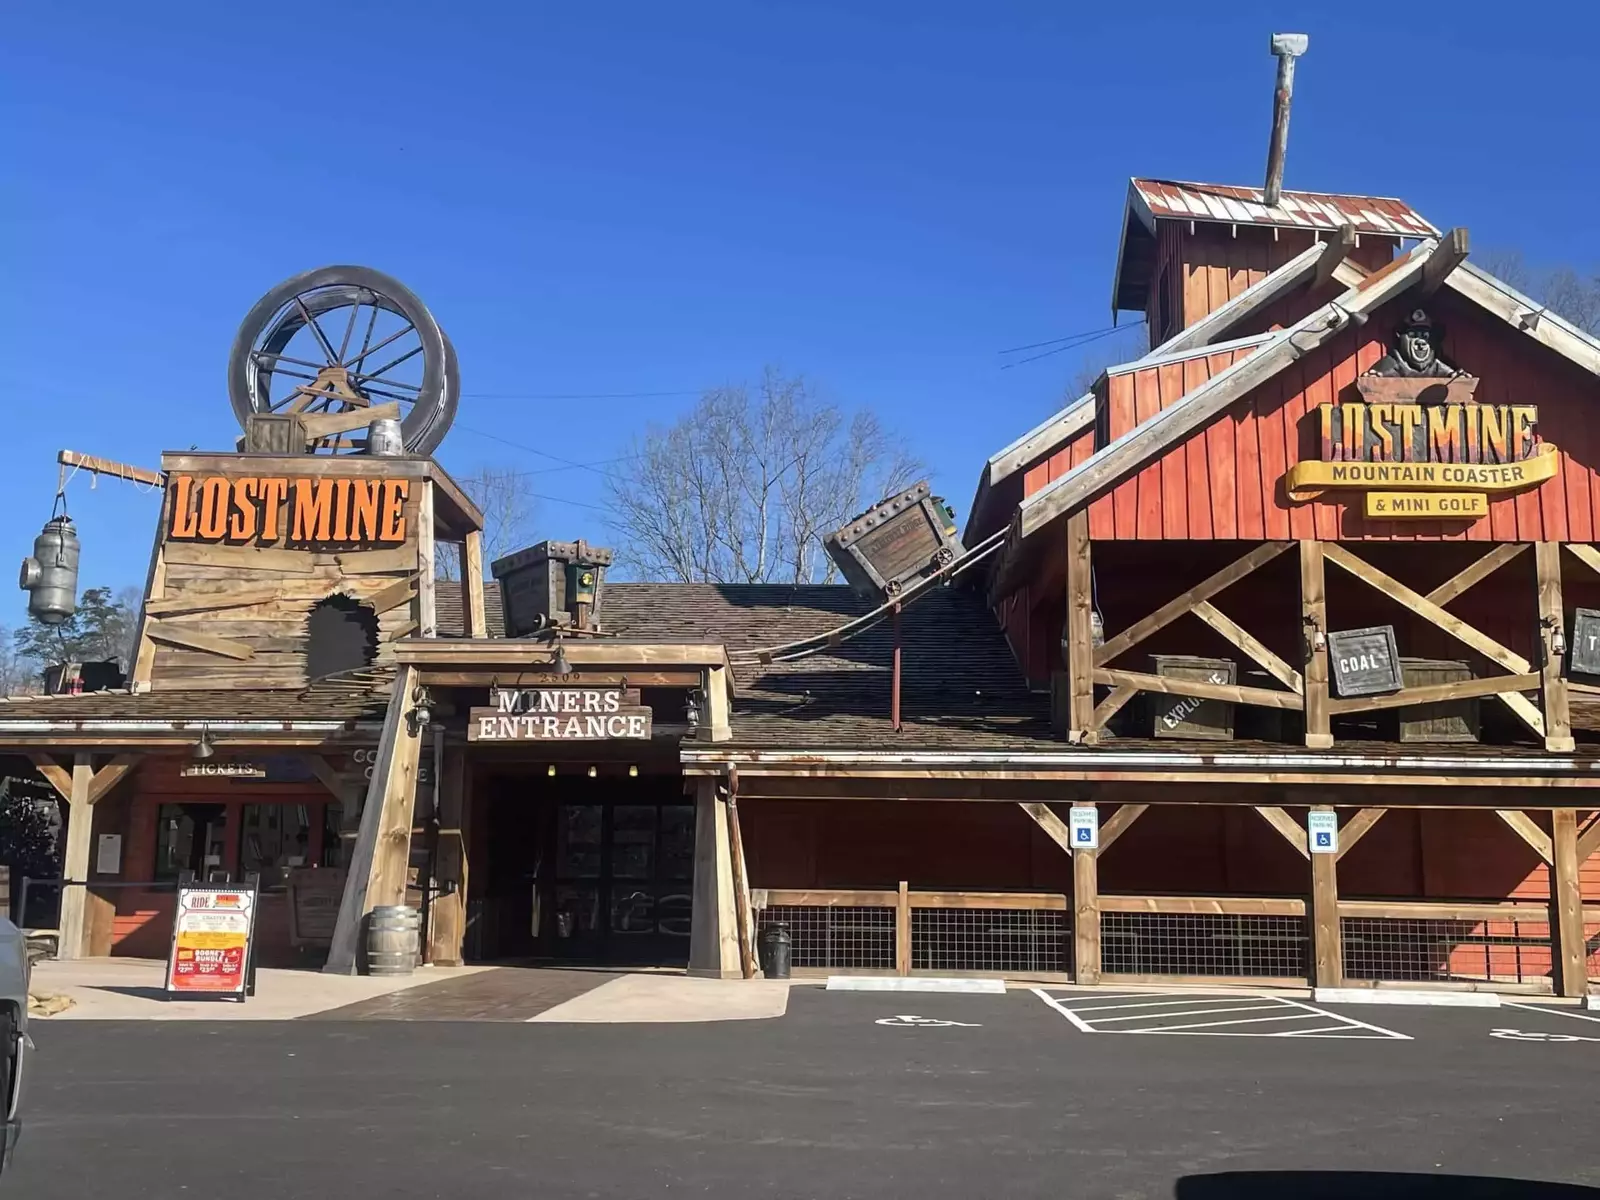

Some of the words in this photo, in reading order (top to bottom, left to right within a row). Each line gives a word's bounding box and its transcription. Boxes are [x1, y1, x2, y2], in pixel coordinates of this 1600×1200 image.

[1319, 402, 1422, 463] LOST
[1428, 402, 1538, 464] MINE
[1332, 466, 1435, 481] MOUNTAIN
[1442, 466, 1525, 483] COASTER
[171, 476, 288, 540] LOST
[291, 478, 409, 541] MINE
[1376, 499, 1386, 511] &
[1392, 498, 1430, 511] MINI
[1438, 498, 1480, 511] GOLF
[1340, 654, 1380, 674] COAL
[497, 690, 620, 713] MINERS
[478, 716, 646, 739] ENTRANCE
[192, 763, 253, 775] TICKETS
[191, 895, 211, 908] RIDE
